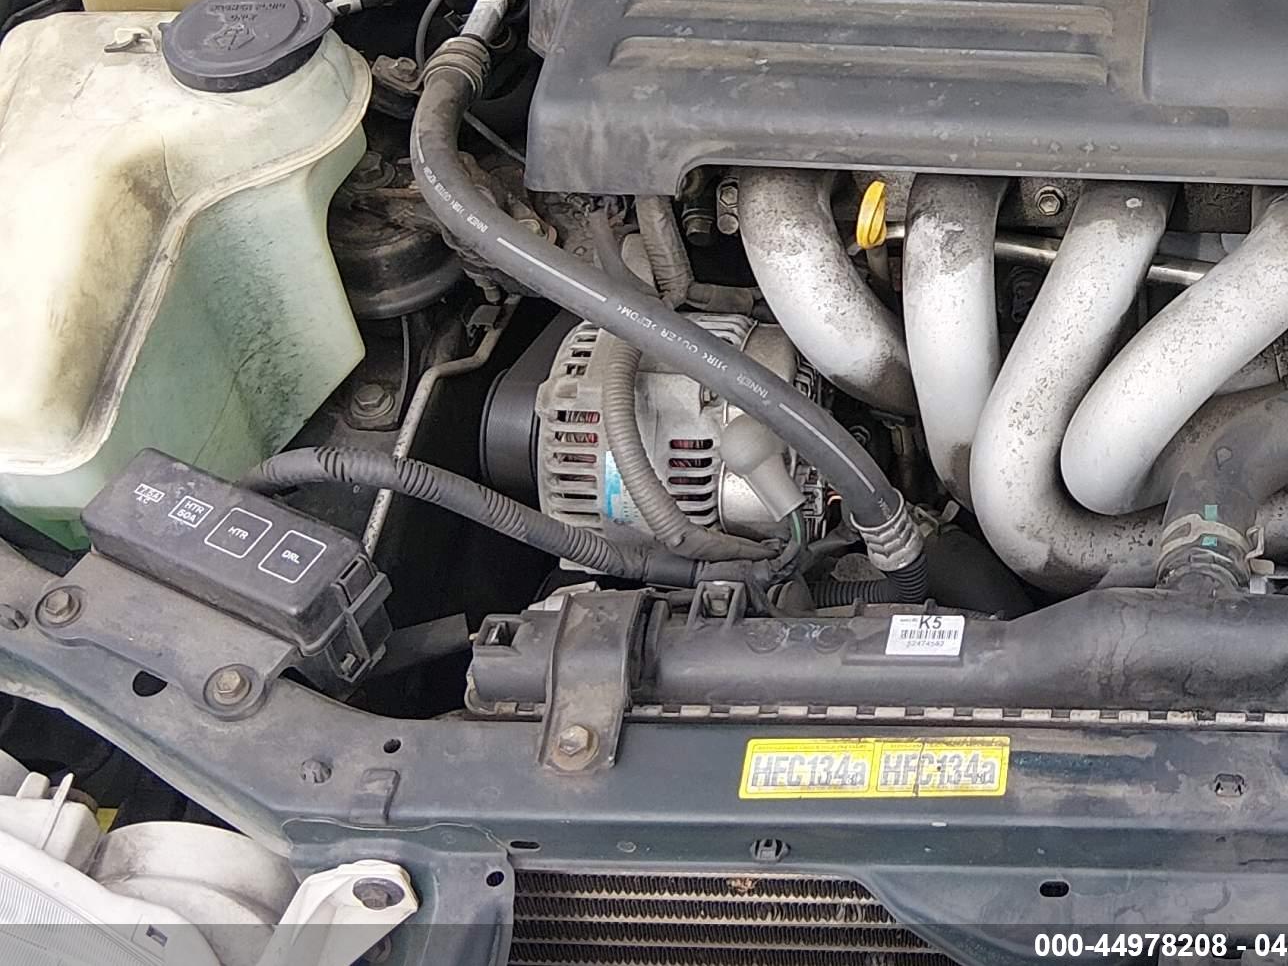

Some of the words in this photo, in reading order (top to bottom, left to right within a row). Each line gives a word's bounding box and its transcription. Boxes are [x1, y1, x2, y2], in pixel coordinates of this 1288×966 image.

[736, 373, 769, 398] INNER
[184, 501, 205, 514] HTR
[228, 526, 249, 540] HTR
[282, 550, 300, 564] DRL
[919, 615, 942, 629] K5
[751, 754, 866, 786] HFC134a
[879, 753, 997, 786] HFC134a
